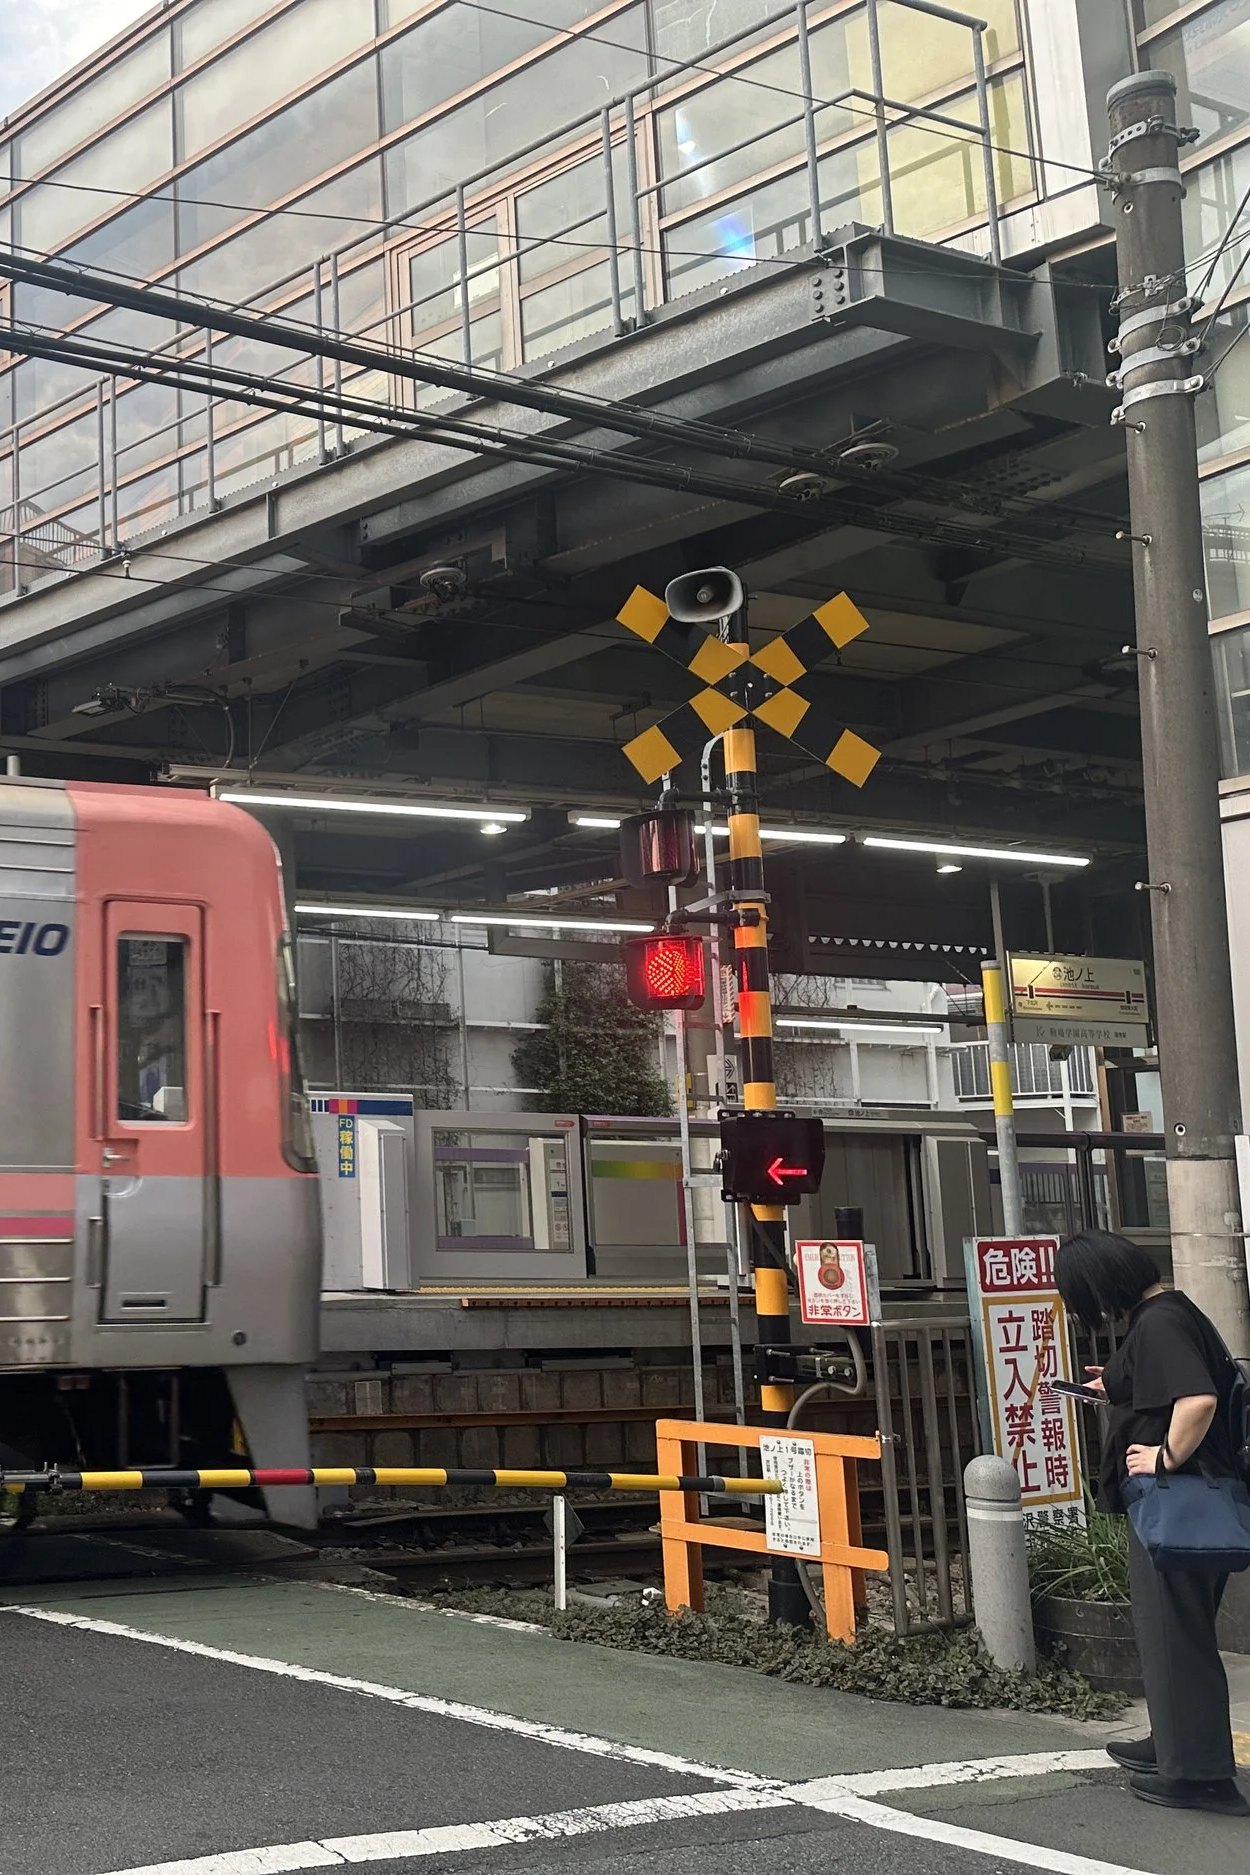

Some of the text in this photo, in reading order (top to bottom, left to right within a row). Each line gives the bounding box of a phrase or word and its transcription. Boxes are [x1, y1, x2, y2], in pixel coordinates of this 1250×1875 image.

[1063, 966, 1095, 983] 池ノ上
[982, 1246, 1056, 1286] 危険!!
[808, 1304, 862, 1318] 非常ボタン
[997, 1310, 1041, 1493] 立入禁止
[1031, 1308, 1069, 1489] 踏切警報時
